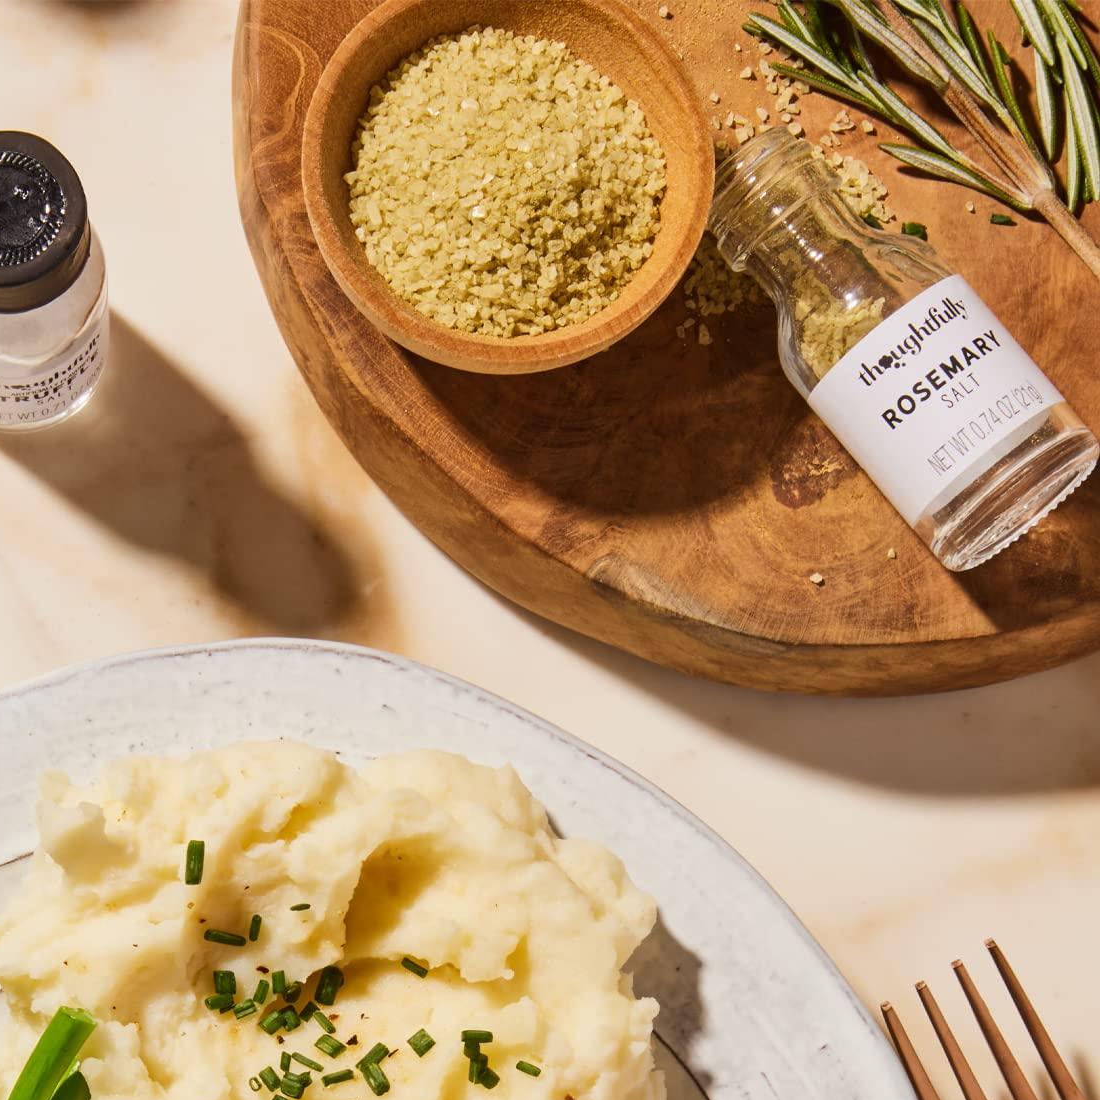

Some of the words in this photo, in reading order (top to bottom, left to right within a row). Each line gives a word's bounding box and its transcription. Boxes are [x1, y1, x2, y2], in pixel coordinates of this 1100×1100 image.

[881, 330, 1001, 430] ROSEMARY
[940, 372, 981, 409] SALT
[927, 444, 956, 477] NET
[948, 427, 975, 456] WT
[969, 408, 1003, 440] 0.74
[996, 394, 1020, 419] OZ
